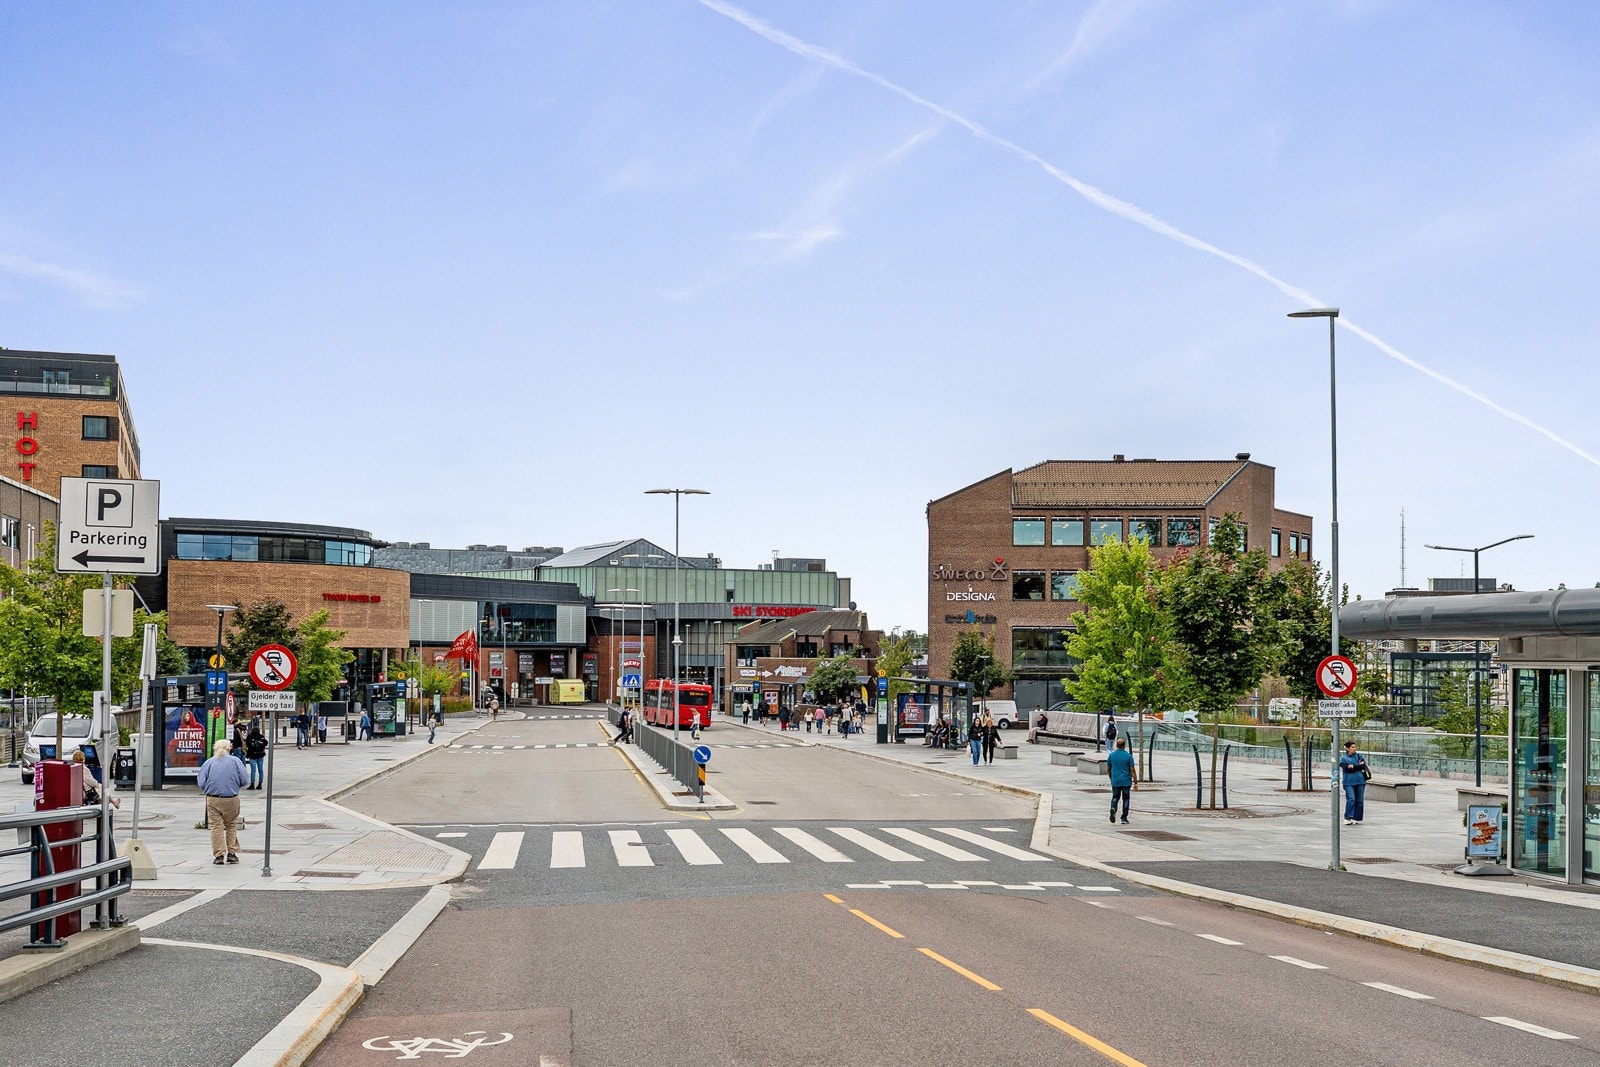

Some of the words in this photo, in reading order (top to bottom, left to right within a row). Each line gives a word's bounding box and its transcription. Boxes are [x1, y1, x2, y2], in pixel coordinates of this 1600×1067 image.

[97, 488, 122, 521] P
[70, 530, 147, 549] Parkering
[933, 570, 985, 580] SWECO
[946, 592, 996, 601] DESIGNA
[732, 606, 752, 617] SKI
[250, 692, 276, 700] Gjelder
[279, 693, 294, 701] ikke
[174, 731, 188, 740] LITT
[189, 731, 205, 741] MYE,
[178, 740, 201, 748] ELLER?
